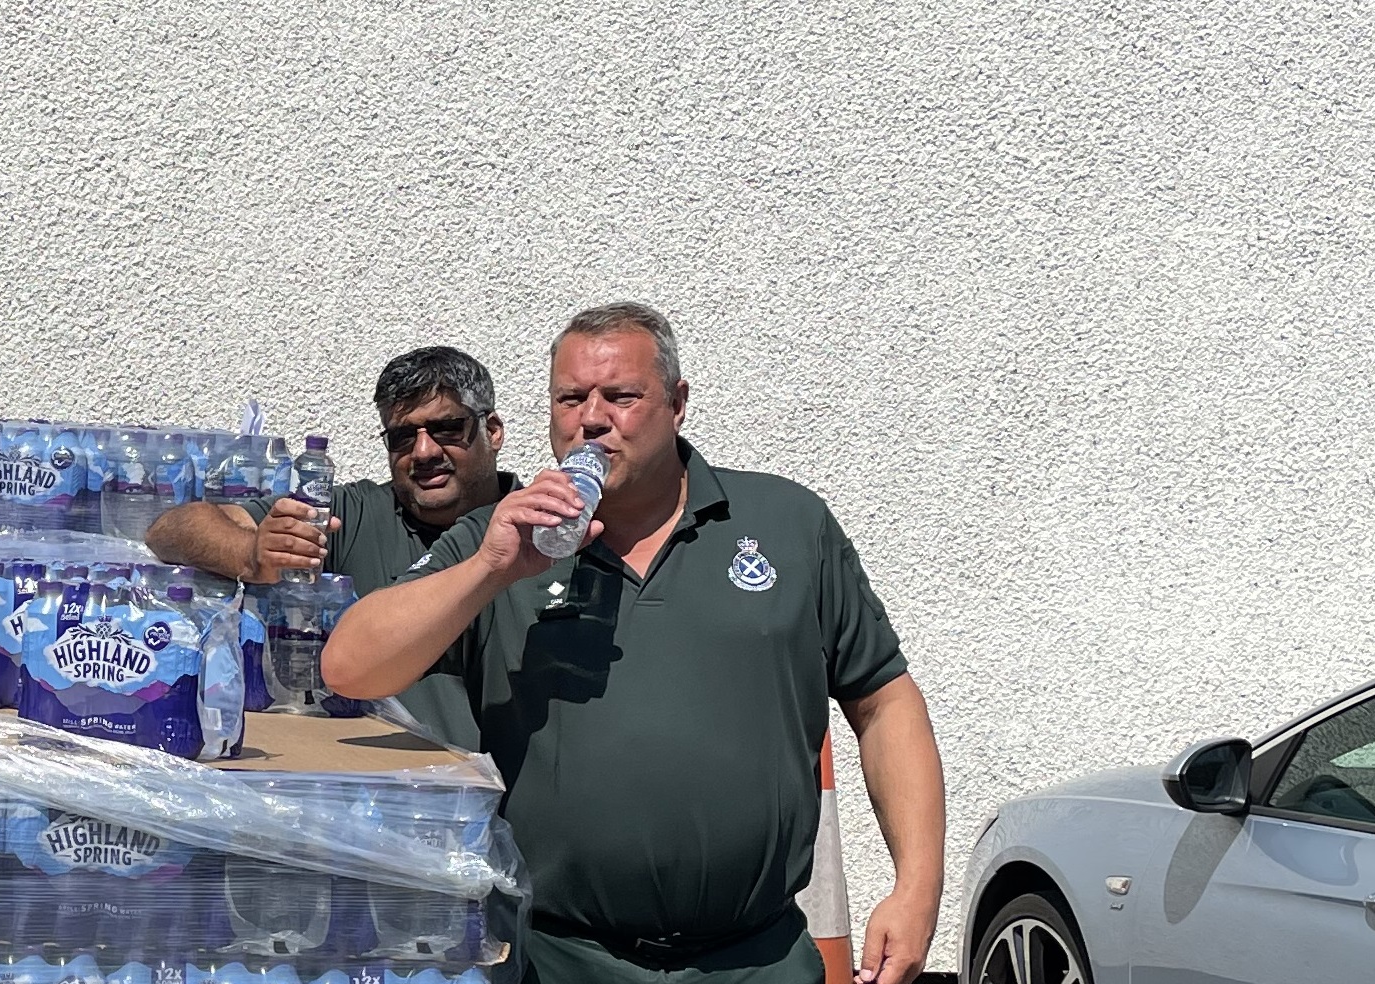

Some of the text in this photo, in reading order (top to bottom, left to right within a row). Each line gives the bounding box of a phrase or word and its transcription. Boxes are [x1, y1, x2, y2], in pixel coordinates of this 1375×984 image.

[63, 602, 81, 614] 12x
[53, 639, 151, 675] HIGHLAND
[74, 662, 125, 683] SPRING
[80, 716, 113, 729] SPRING
[46, 822, 161, 857] HIGHLAND
[73, 846, 132, 866] SPRING
[156, 967, 182, 981] 12x
